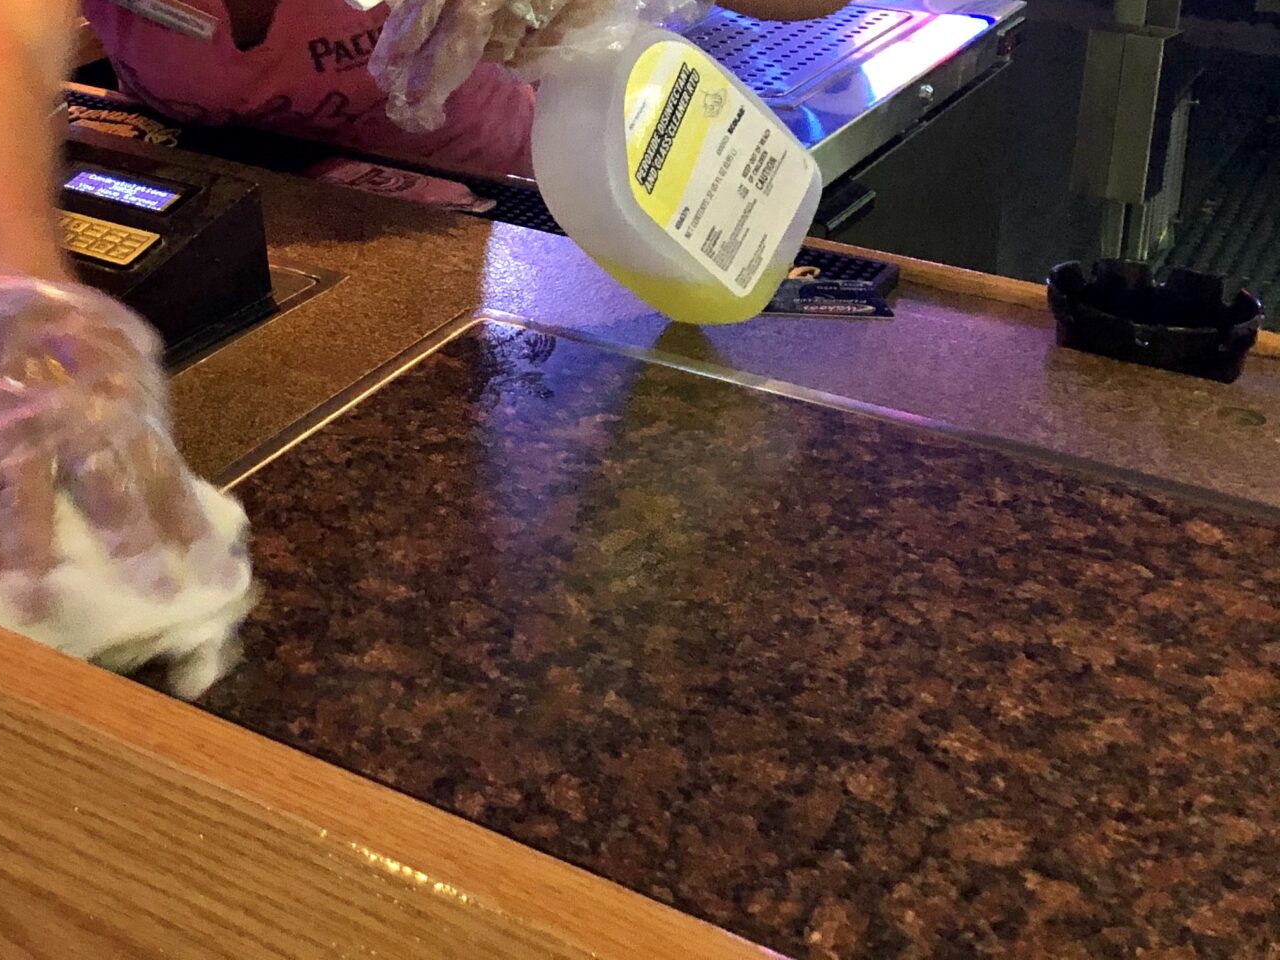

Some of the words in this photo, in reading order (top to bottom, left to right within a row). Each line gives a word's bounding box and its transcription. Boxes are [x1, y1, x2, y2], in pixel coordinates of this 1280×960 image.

[634, 134, 663, 186] PEROXIDE
[657, 64, 692, 135] DISINFECTANT
[644, 169, 659, 193] AND
[653, 135, 673, 171] GLASS
[666, 91, 691, 138] CLEANER
[685, 70, 700, 96] RTU
[88, 173, 169, 198] Congratulations
[754, 154, 777, 190] CAUTION
